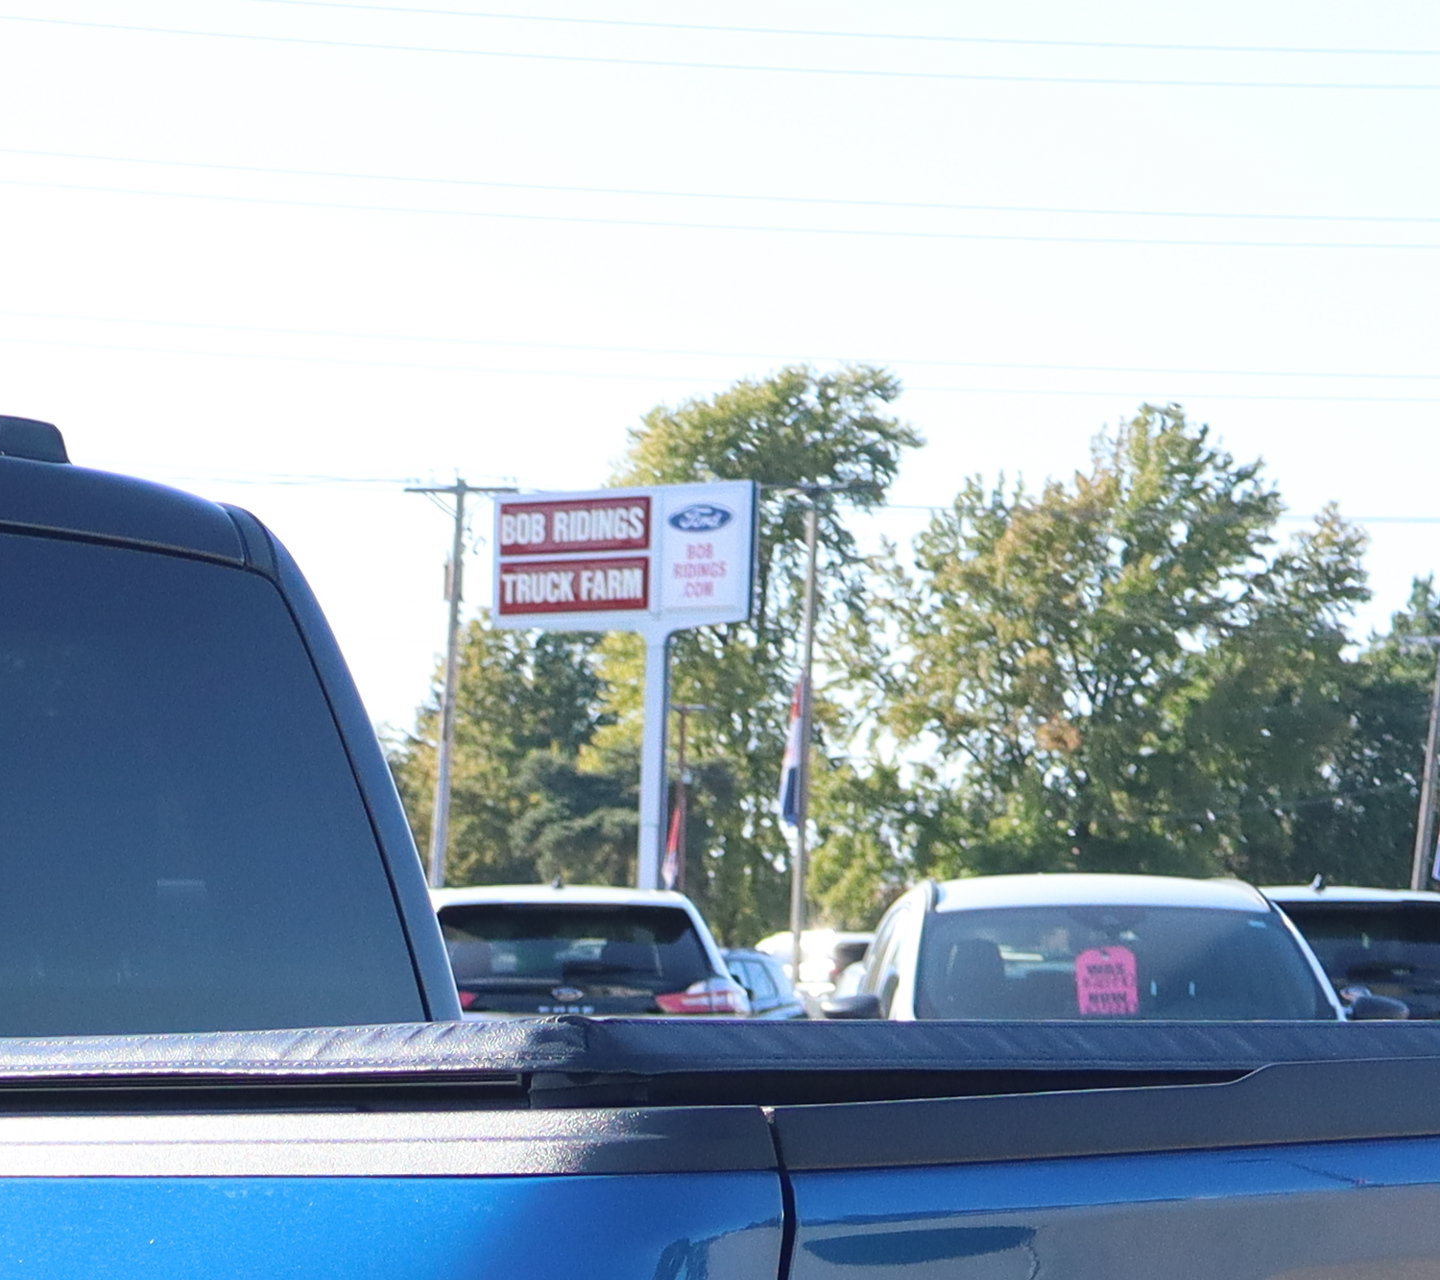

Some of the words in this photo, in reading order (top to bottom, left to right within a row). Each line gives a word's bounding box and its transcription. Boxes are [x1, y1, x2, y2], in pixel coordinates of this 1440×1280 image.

[502, 513, 546, 545] BOB
[553, 506, 645, 542] RIDINGS
[686, 542, 714, 559] BOB
[673, 561, 727, 578] RIDINGS
[501, 572, 574, 604] TRUCK
[580, 568, 643, 601] FARM
